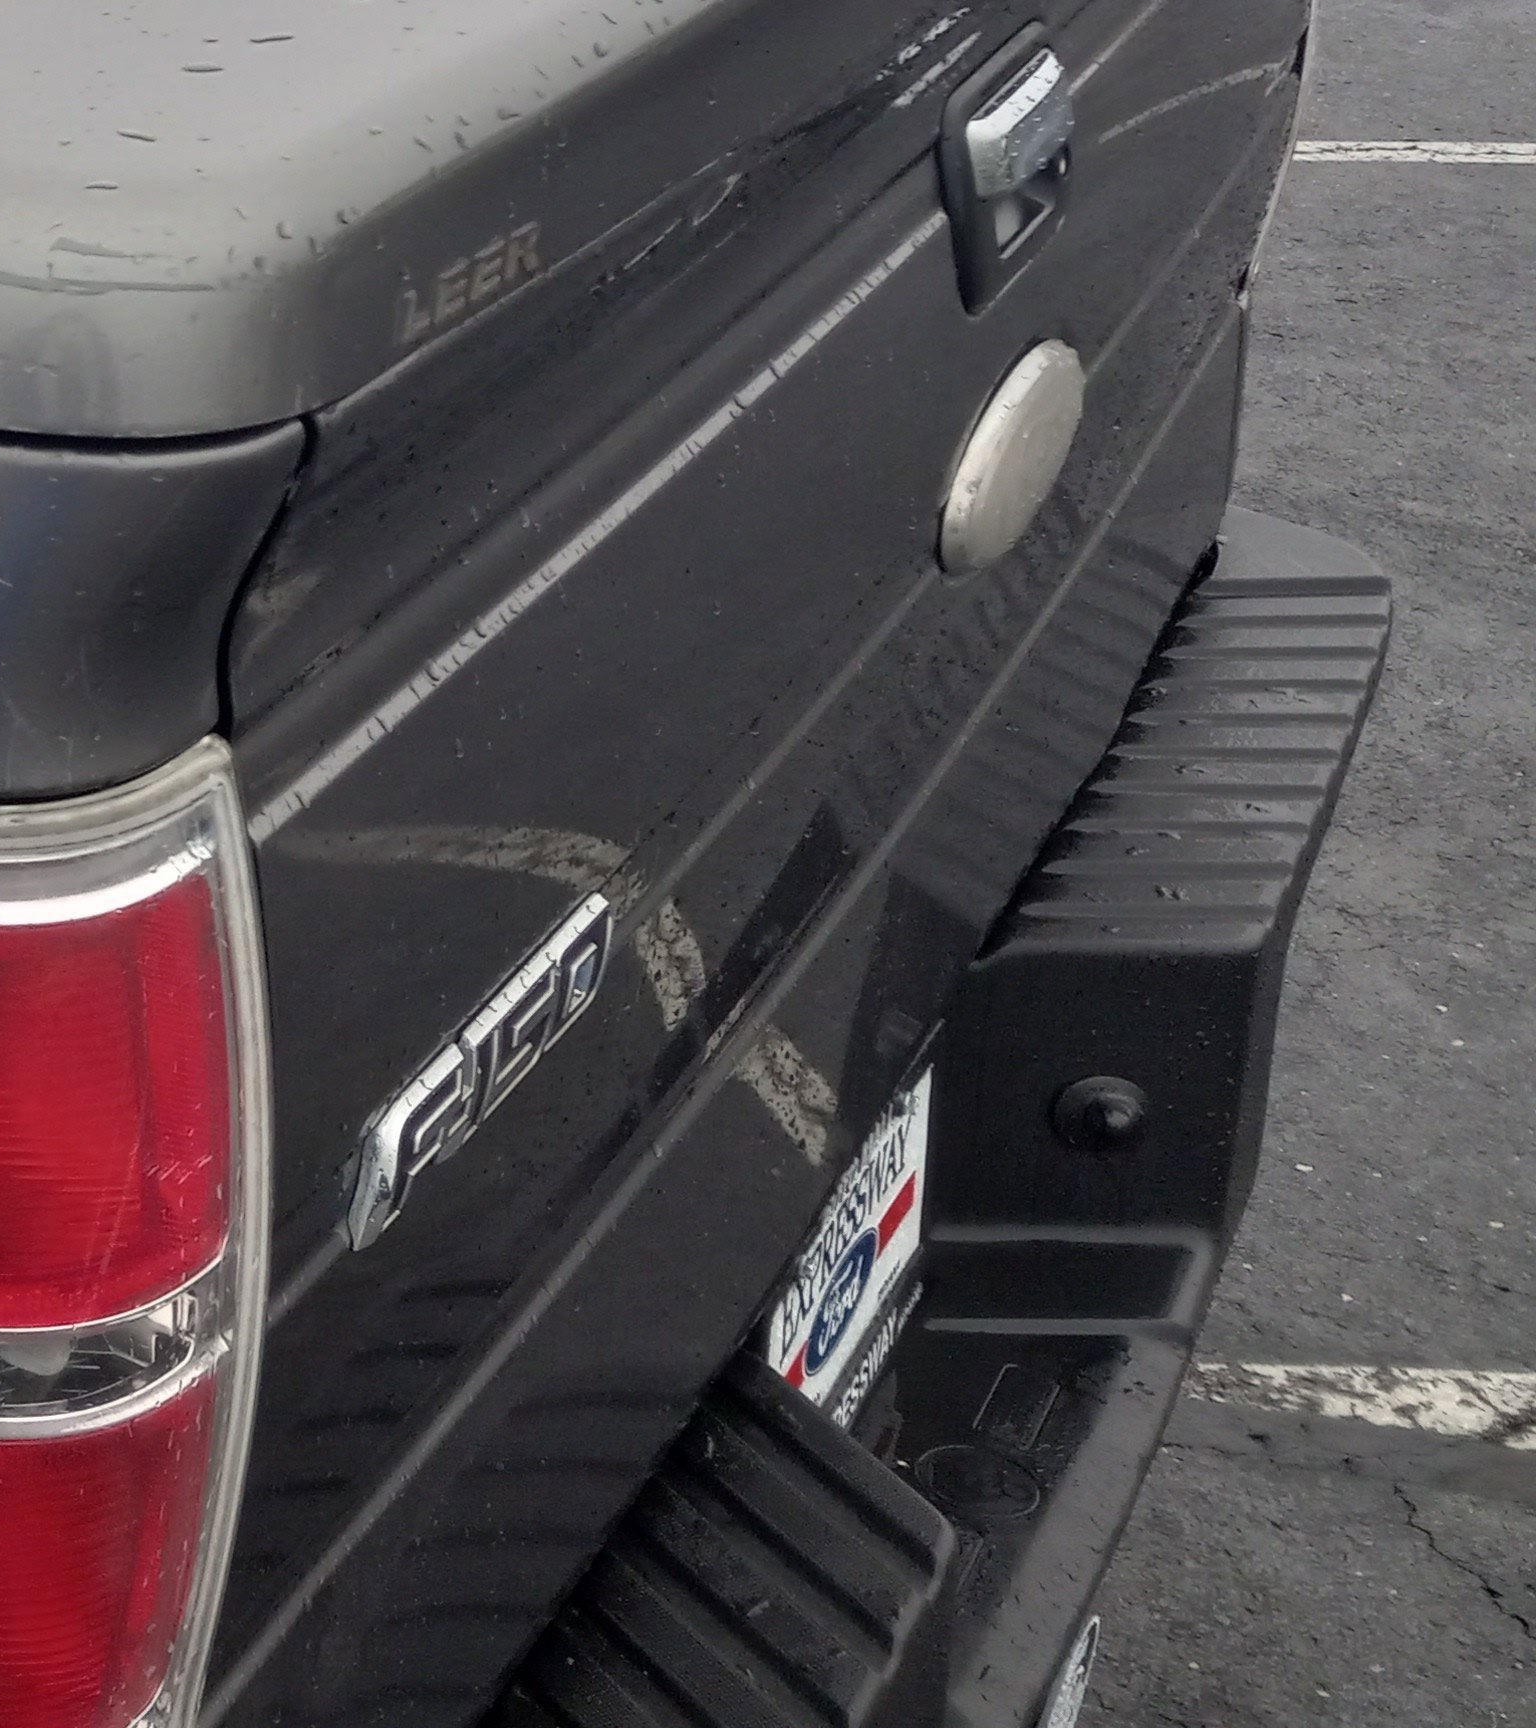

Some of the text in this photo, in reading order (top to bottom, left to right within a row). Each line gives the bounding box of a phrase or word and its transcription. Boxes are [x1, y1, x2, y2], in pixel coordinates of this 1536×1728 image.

[395, 221, 542, 345] LEER
[779, 1115, 912, 1367] EXPRESSWAY
[817, 1254, 864, 1357] Ford
